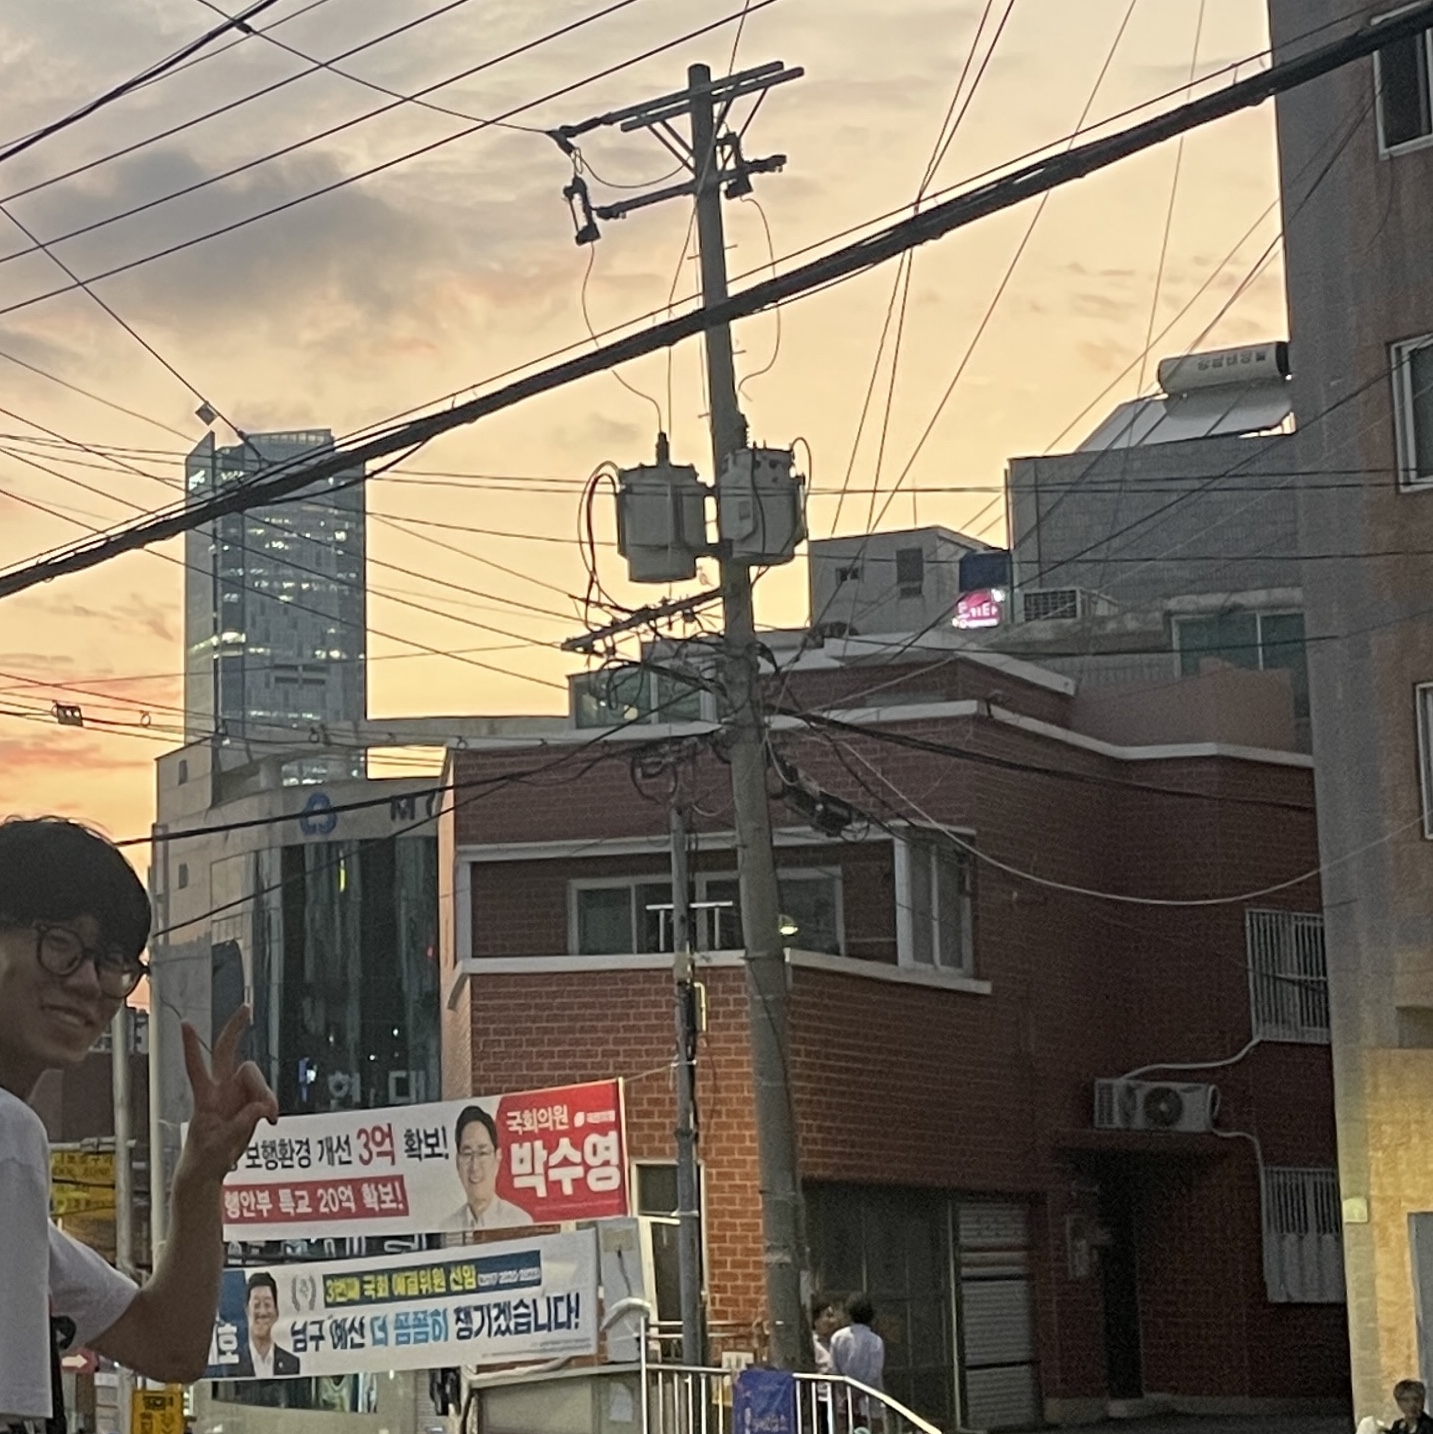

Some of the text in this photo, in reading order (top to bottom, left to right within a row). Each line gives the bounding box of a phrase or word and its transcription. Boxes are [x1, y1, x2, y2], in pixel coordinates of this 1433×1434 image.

[506, 1104, 569, 1136] 국회의원
[245, 1137, 312, 1171] 보행환경
[318, 1134, 353, 1167] 개선
[356, 1122, 396, 1167] 3억
[403, 1125, 450, 1161] 확보!
[510, 1130, 621, 1198] 박수영
[223, 1180, 404, 1219] 행안부 특교 20억 확보!
[363, 1274, 390, 1300] 국회
[449, 1264, 478, 1292] 선임
[291, 1292, 580, 1353] 남구 예산 더 꼼꼼히 챙기겠습니다!
